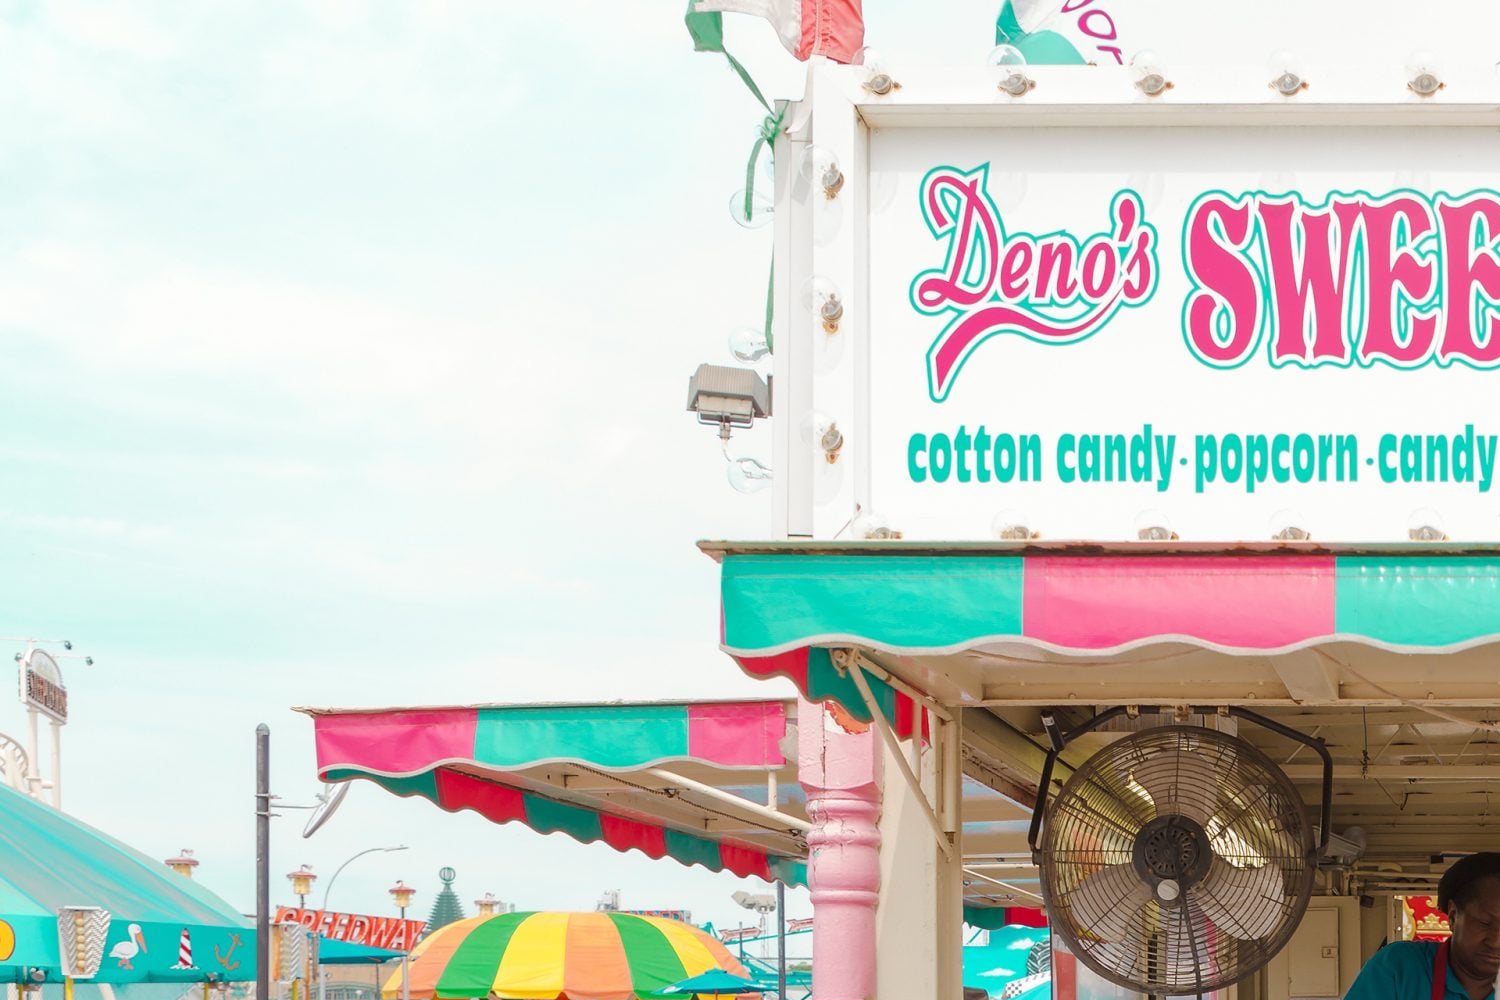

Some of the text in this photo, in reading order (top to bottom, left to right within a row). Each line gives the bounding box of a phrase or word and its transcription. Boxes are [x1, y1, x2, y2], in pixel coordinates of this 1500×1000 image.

[911, 165, 1158, 325] Deno's
[907, 423, 1042, 484] cotton
[1055, 422, 1177, 493] candy
[1194, 433, 1359, 494] popcorn
[1377, 422, 1499, 493] candy
